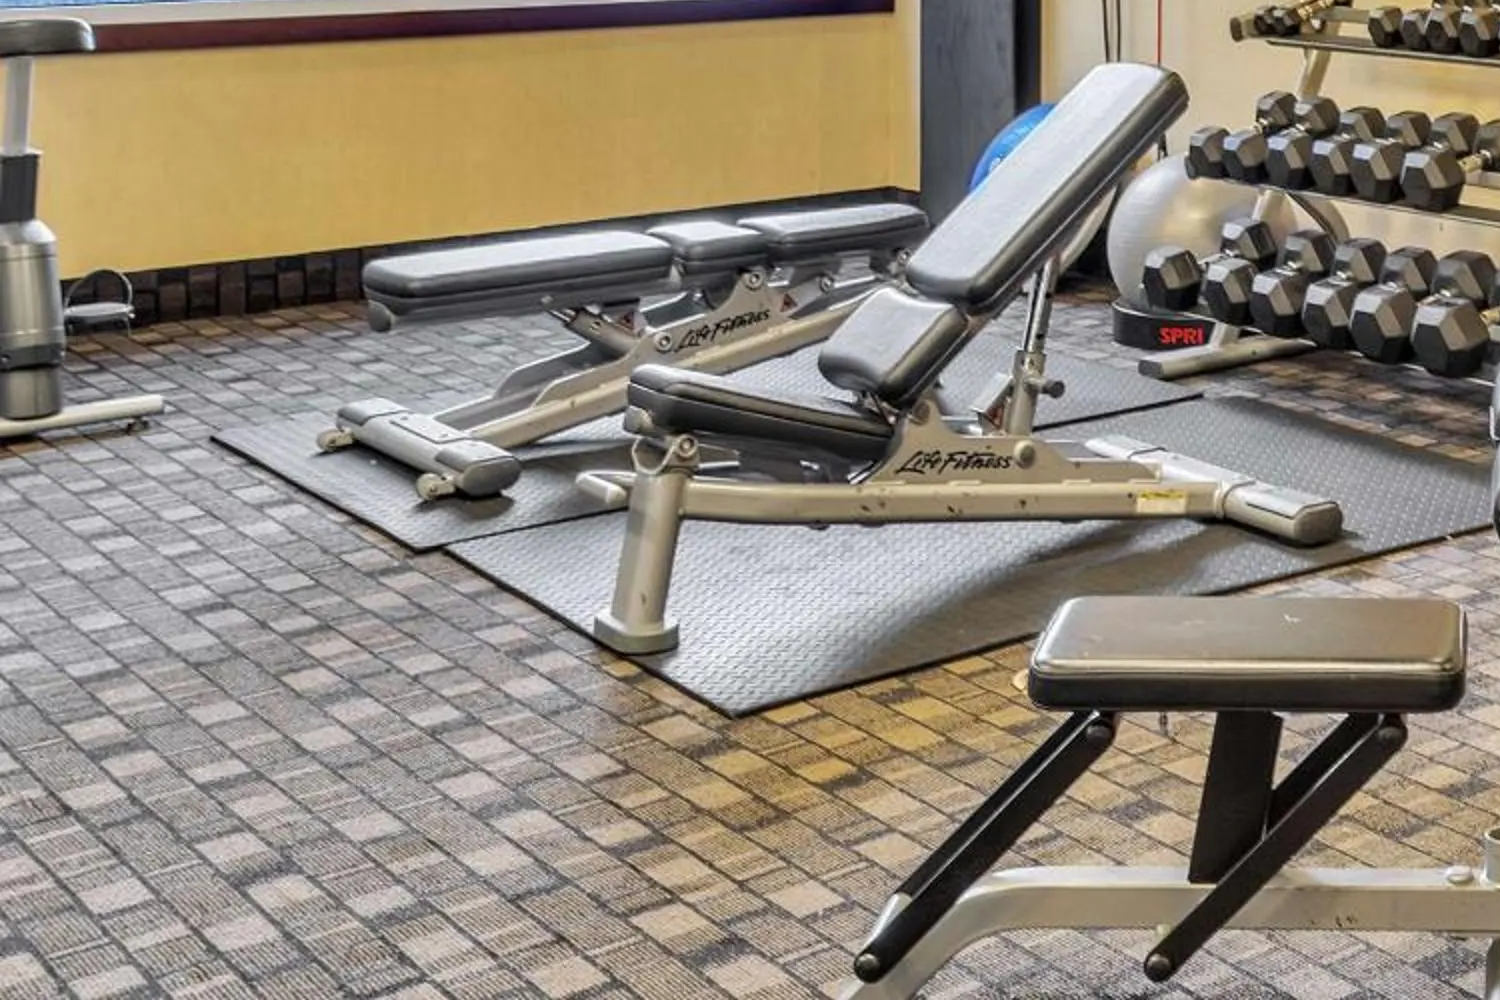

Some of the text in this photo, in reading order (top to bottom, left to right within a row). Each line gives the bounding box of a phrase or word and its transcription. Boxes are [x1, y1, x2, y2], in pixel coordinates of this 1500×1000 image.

[711, 308, 771, 343] Fitness
[1160, 327, 1203, 345] SPRI
[895, 450, 1013, 475] Life Fitness
